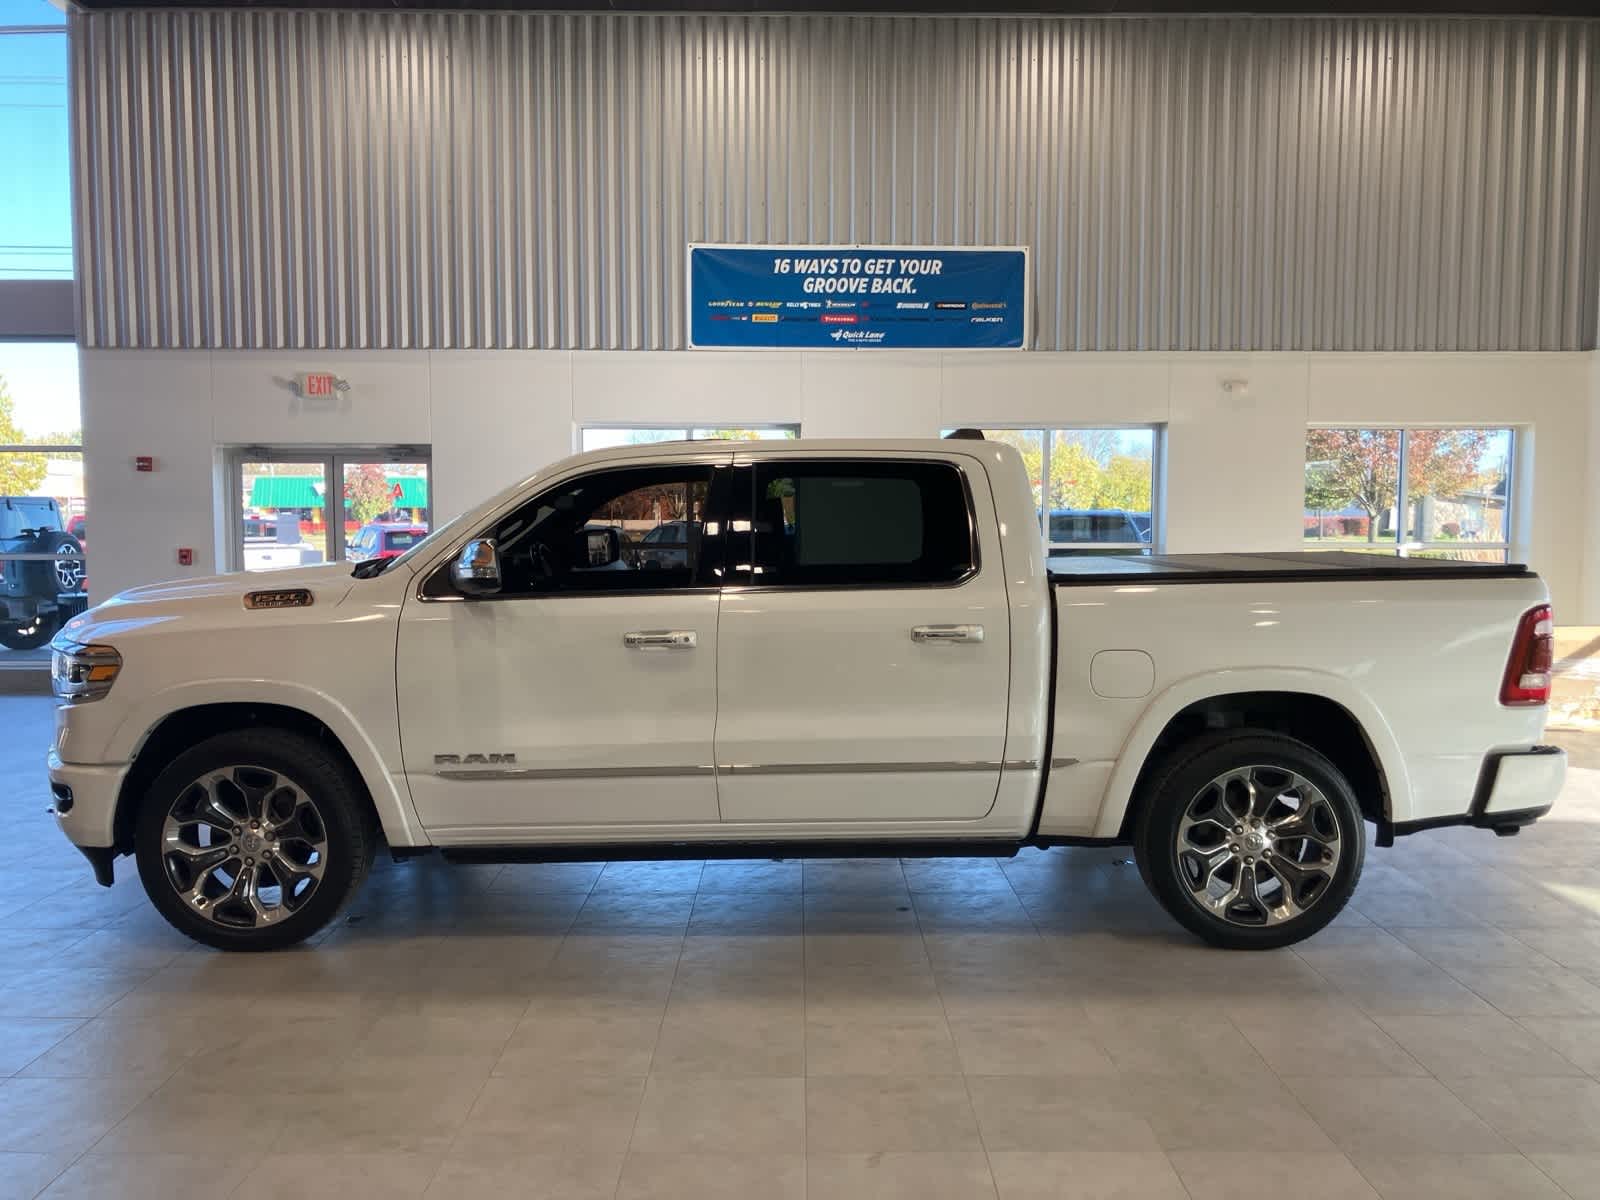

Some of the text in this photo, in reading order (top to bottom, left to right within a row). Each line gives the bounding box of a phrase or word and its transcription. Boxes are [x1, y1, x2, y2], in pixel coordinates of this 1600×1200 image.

[773, 258, 942, 275] 16 WAYS TO GET YOUR
[803, 277, 917, 294] GROOVE BACK.
[842, 331, 865, 339] Quick
[307, 375, 333, 395] EXIT
[434, 753, 516, 764] RAM
